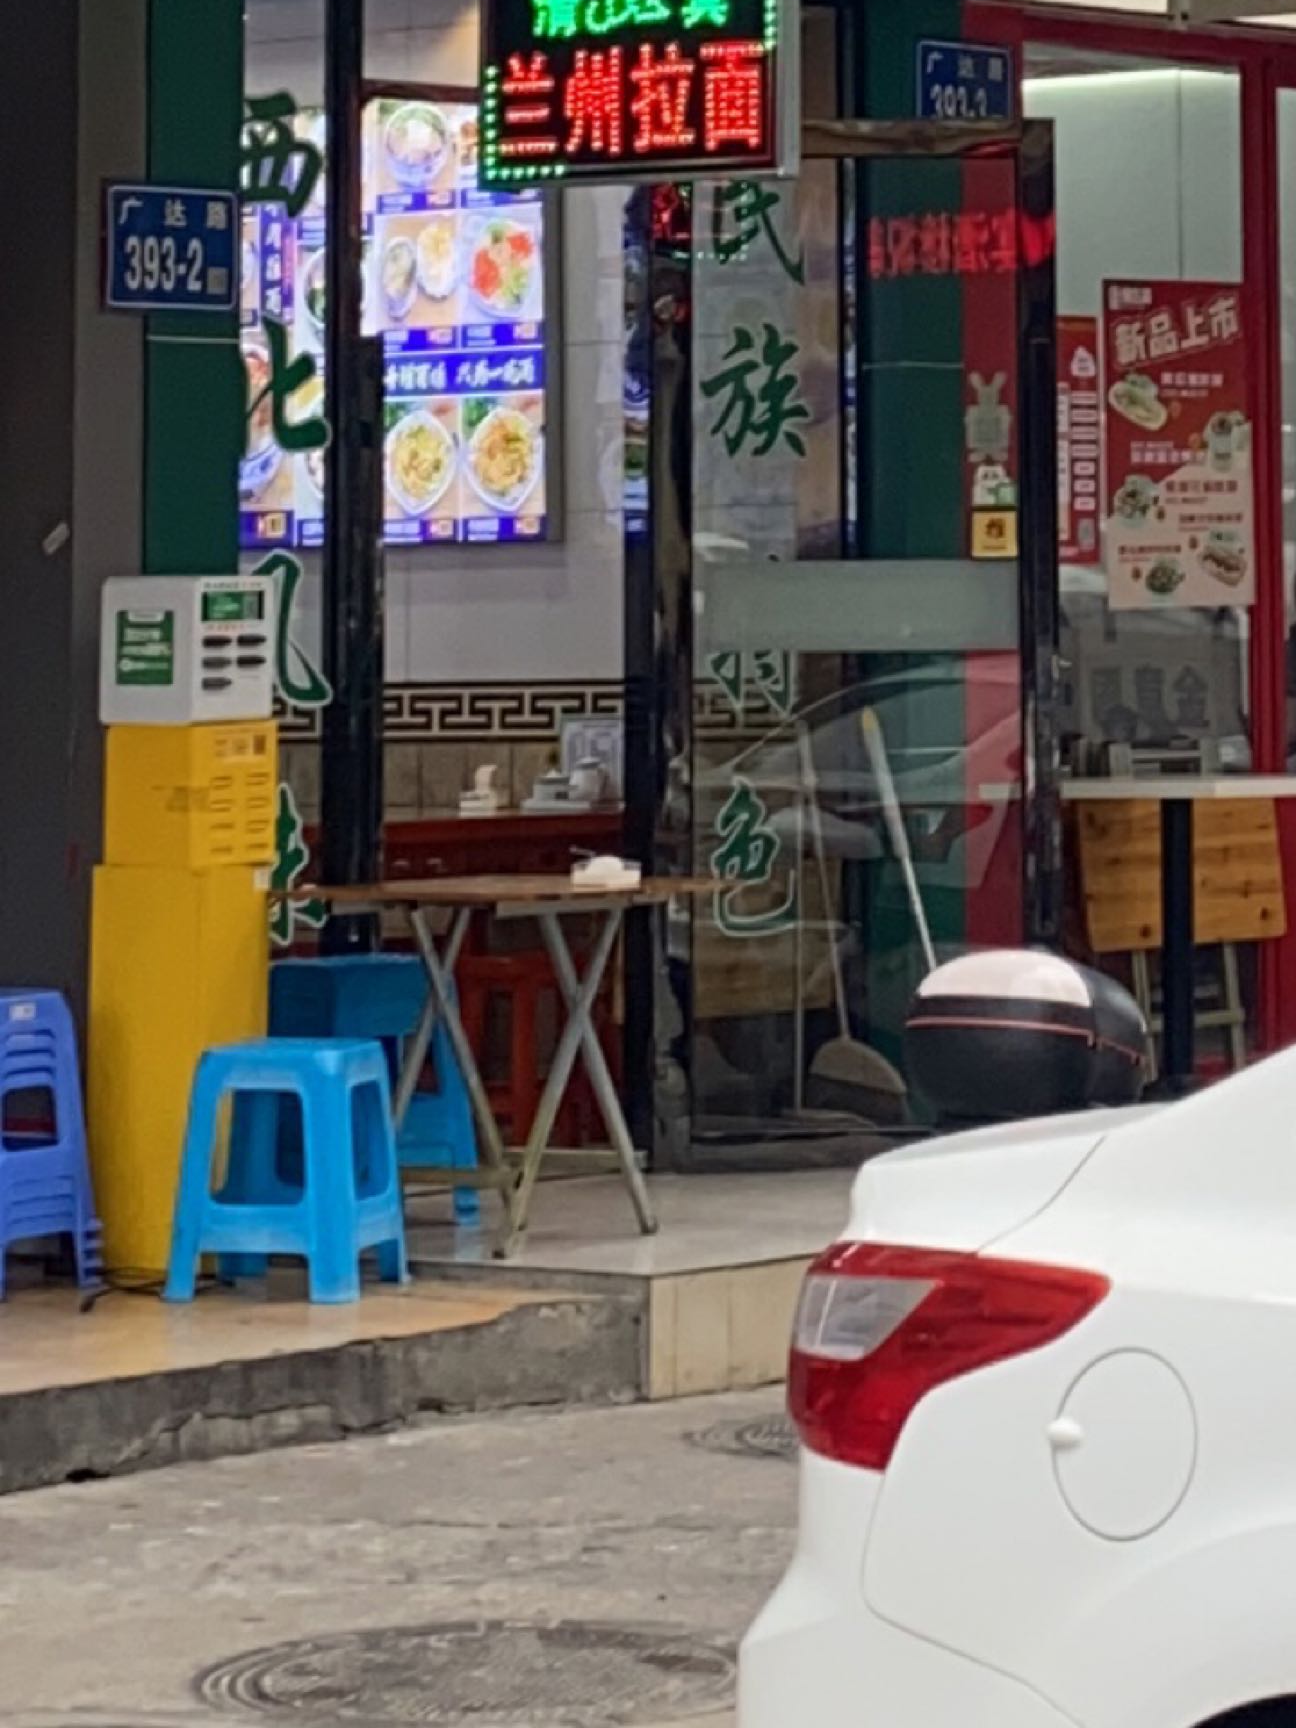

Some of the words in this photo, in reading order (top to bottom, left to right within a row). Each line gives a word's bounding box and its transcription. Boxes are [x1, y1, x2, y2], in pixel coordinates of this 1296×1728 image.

[500, 40, 765, 154] 兰州拉面
[1114, 296, 1240, 366] 新品上市
